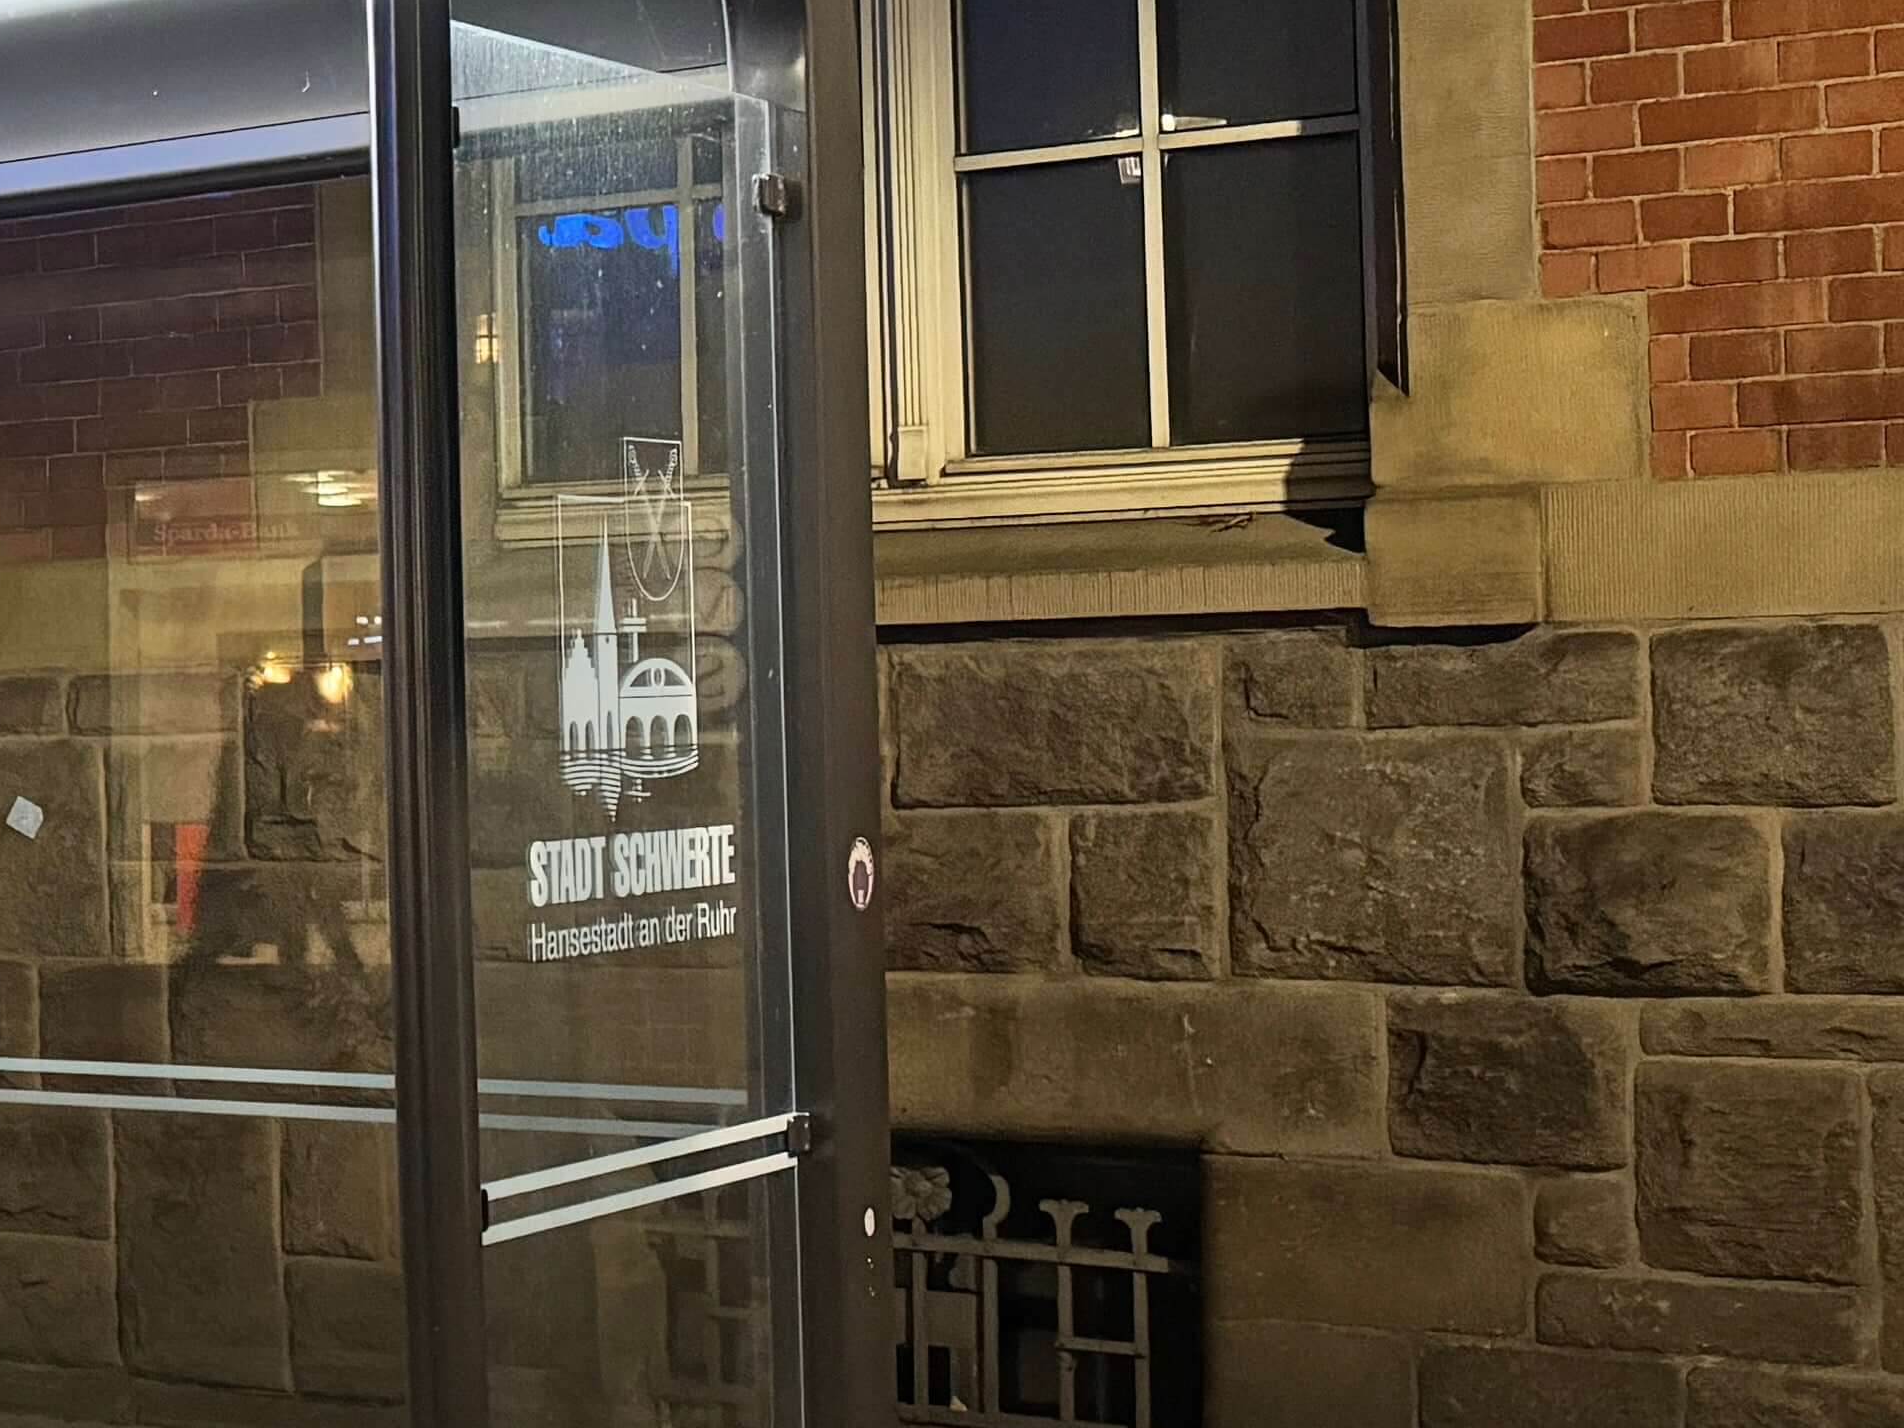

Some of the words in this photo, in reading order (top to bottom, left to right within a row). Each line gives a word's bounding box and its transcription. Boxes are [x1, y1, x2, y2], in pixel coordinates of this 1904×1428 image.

[529, 836, 606, 907] STADT
[613, 824, 736, 898] SCHWERTE
[531, 912, 635, 963] Hansestadt
[637, 916, 661, 946] an
[664, 906, 693, 943] der
[695, 900, 737, 939] Ruhr
